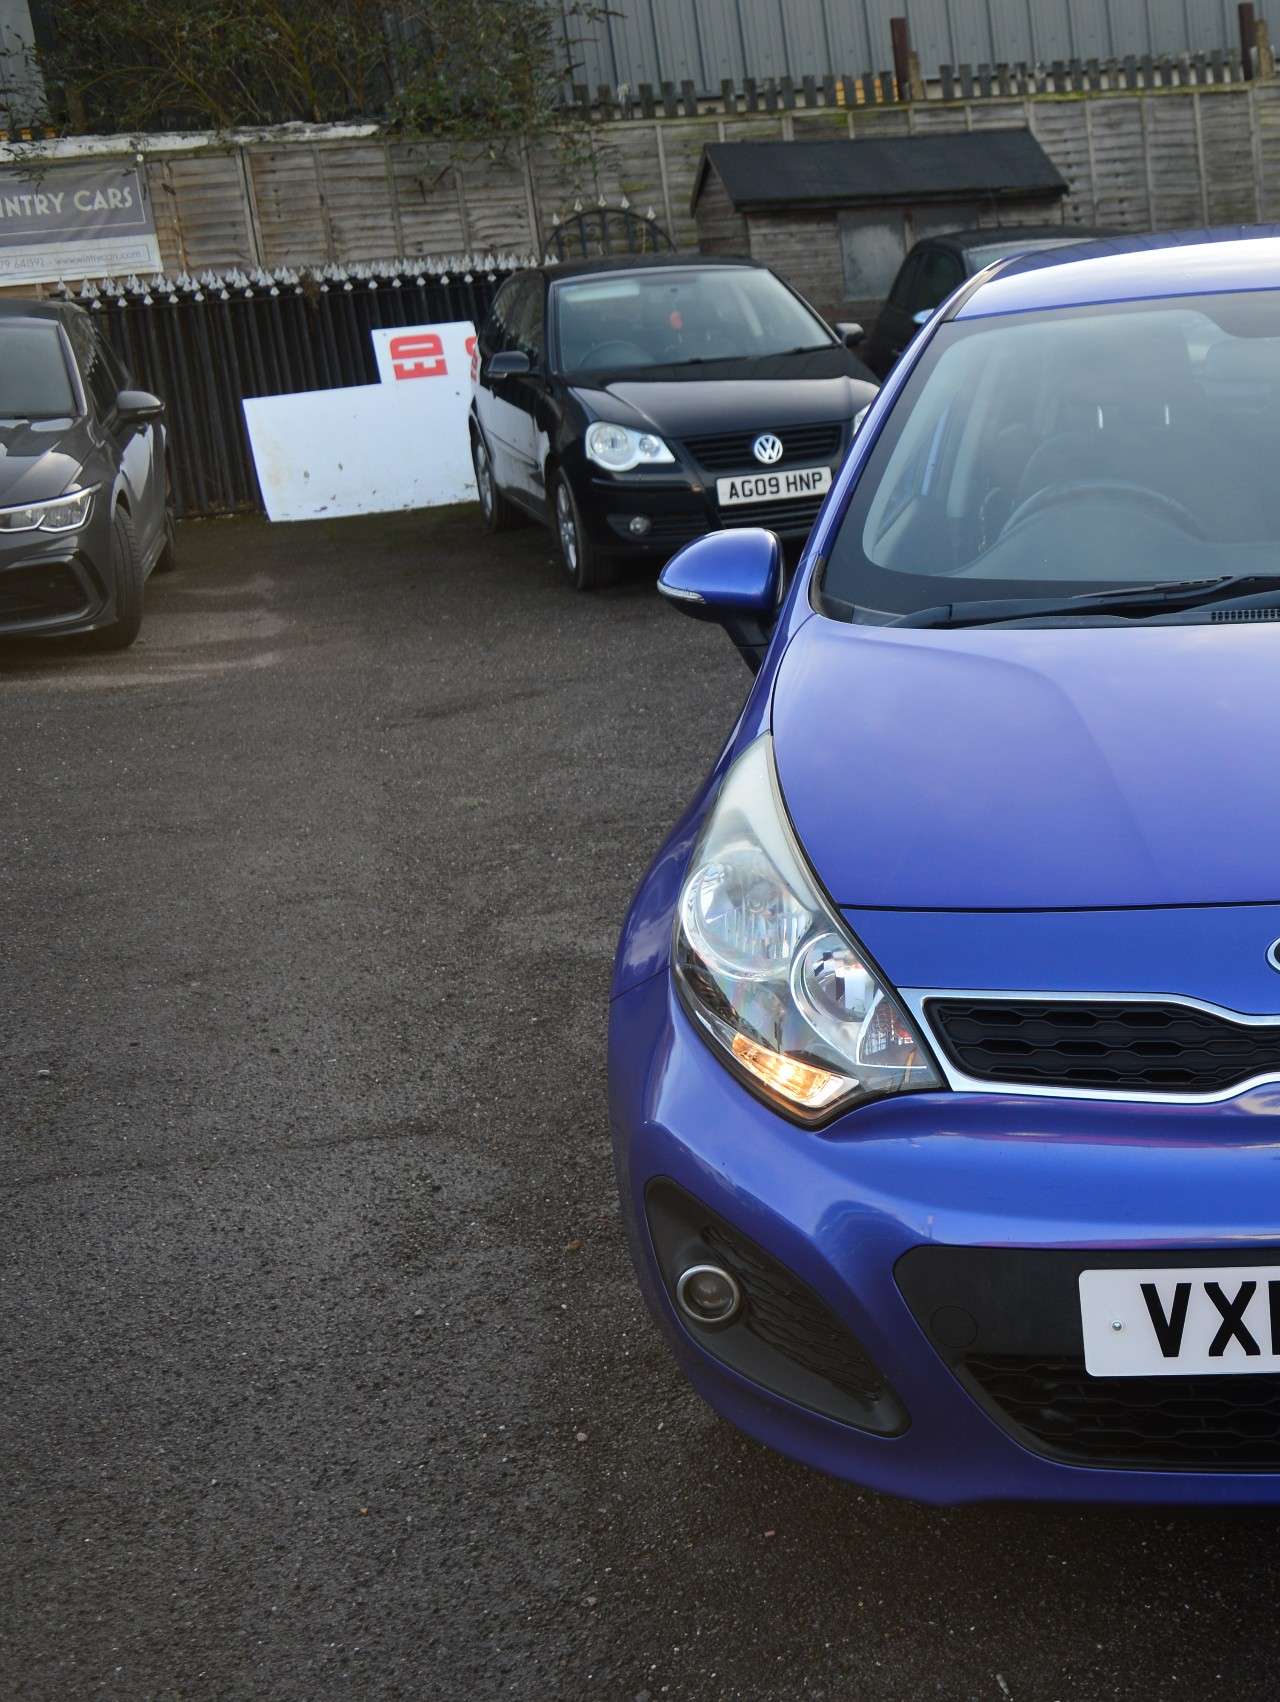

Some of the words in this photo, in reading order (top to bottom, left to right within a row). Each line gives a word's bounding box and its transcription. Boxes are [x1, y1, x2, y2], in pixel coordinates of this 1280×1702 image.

[73, 186, 133, 212] CARS
[729, 476, 780, 500] AG09
[786, 471, 823, 493] HNP
